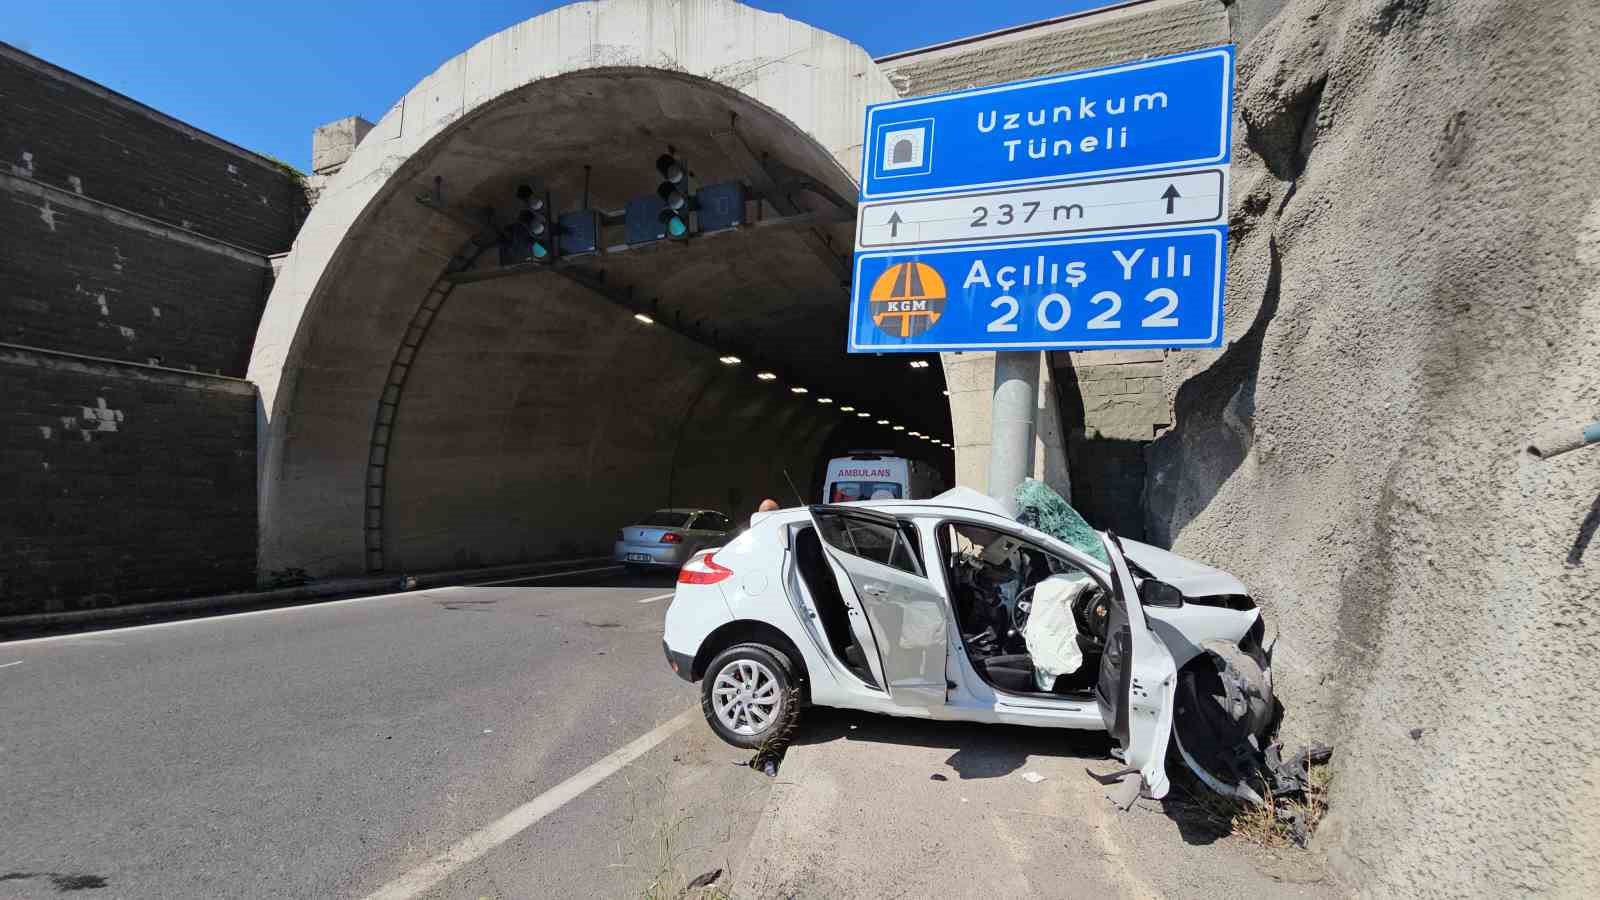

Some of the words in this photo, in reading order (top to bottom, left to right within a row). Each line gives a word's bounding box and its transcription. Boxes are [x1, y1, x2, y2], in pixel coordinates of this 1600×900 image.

[977, 91, 1168, 133] Uzunkum
[1003, 127, 1128, 162] Tüneli
[970, 202, 1041, 228] 237
[1053, 203, 1084, 221] m
[963, 255, 1087, 290] Açılış
[1112, 246, 1192, 280] Yılı
[887, 300, 927, 312] KGM
[986, 287, 1179, 333] 2022
[838, 468, 891, 477] AMBULANS
